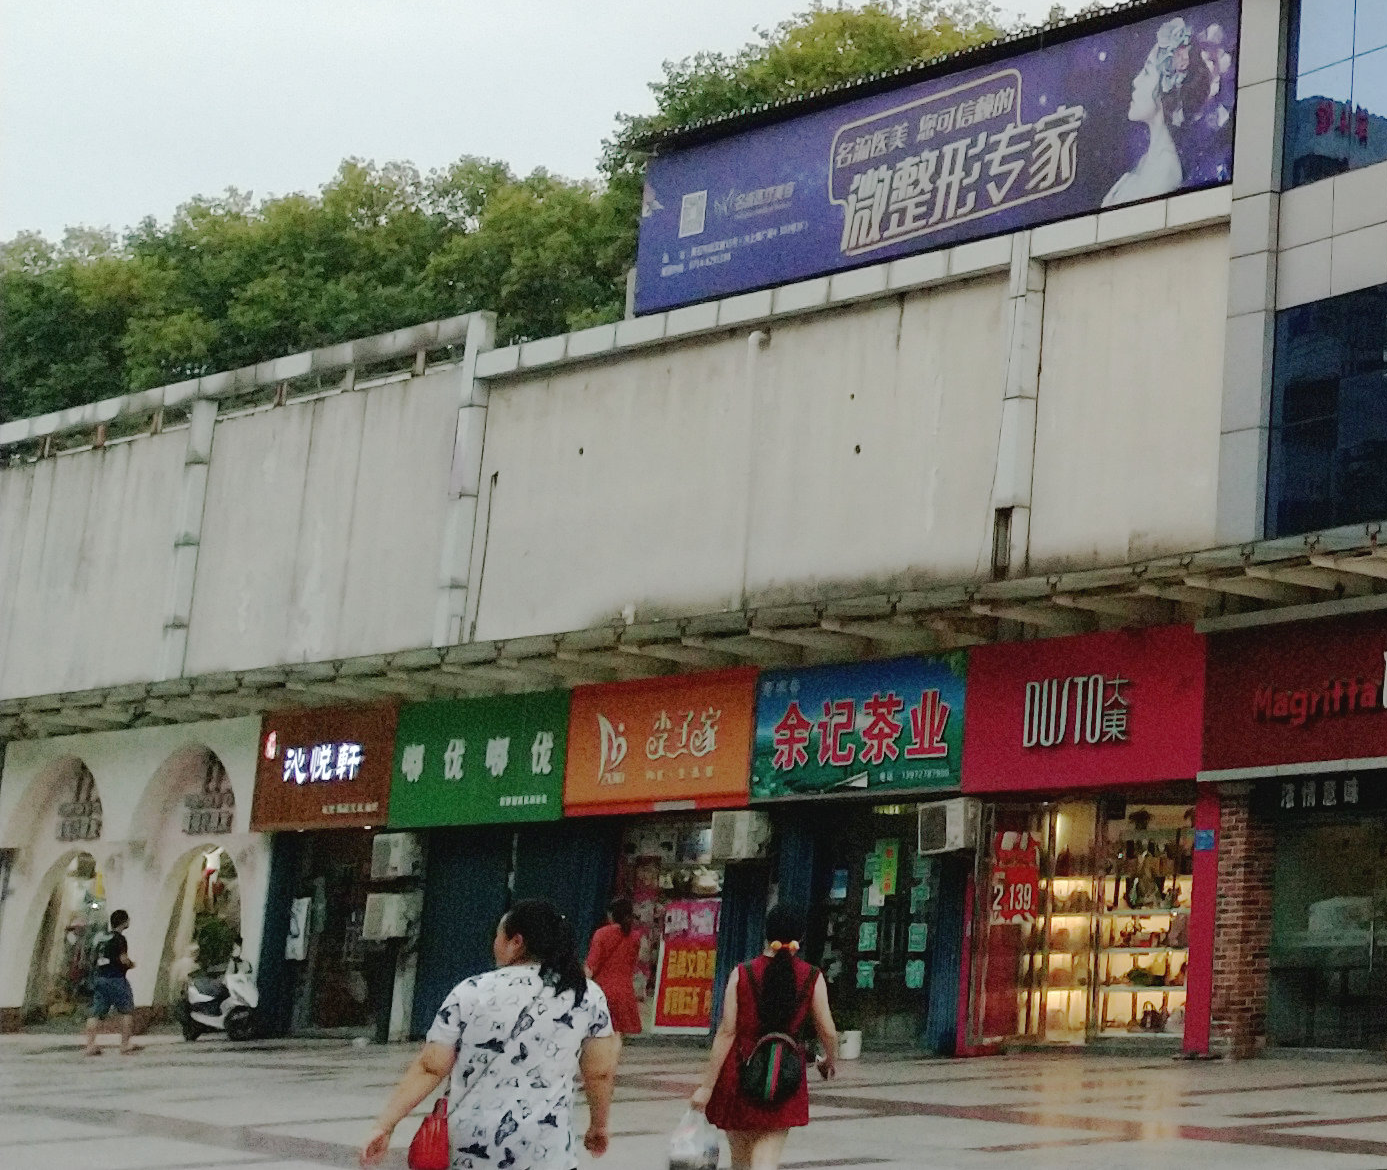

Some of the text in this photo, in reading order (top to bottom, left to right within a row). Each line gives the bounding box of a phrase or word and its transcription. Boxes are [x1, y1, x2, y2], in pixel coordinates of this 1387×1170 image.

[835, 85, 1015, 169] 名流医美 您可信赖的
[840, 103, 1086, 252] 微整形专家
[773, 689, 951, 772] 余记茶业
[1022, 674, 1104, 748] DUSTO
[1102, 673, 1129, 742] 大東
[1009, 883, 1032, 910] 139
